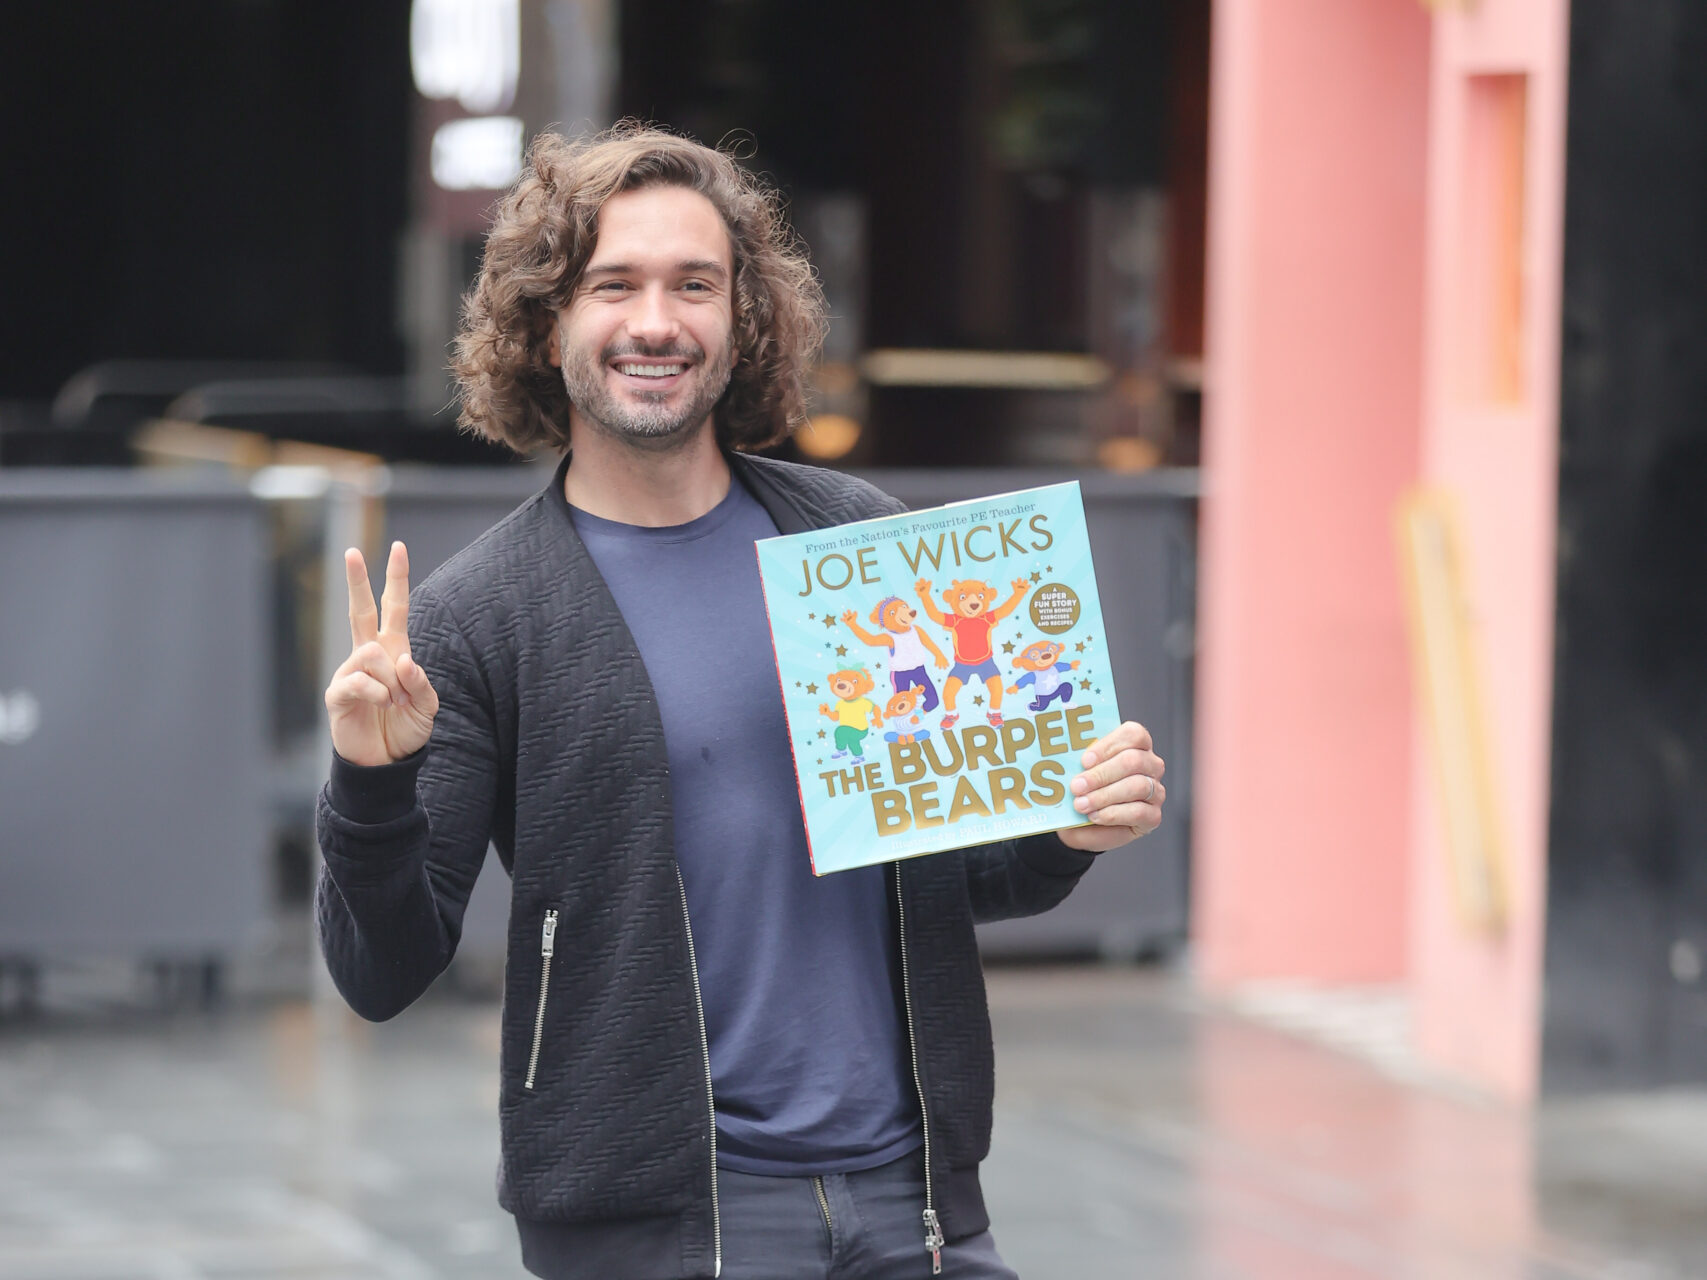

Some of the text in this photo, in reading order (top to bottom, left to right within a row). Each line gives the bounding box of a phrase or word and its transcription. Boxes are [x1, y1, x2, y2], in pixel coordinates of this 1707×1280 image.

[798, 514, 1054, 597] JOE WICKS
[805, 502, 1036, 554] From the Nation's Favourite PE Teacher
[1041, 592, 1066, 600] SUPER
[819, 704, 1098, 798] THE BURPEE
[871, 760, 1066, 837] BEARS
[959, 823, 992, 839] PAUL
[994, 813, 1048, 833] HOWARD
